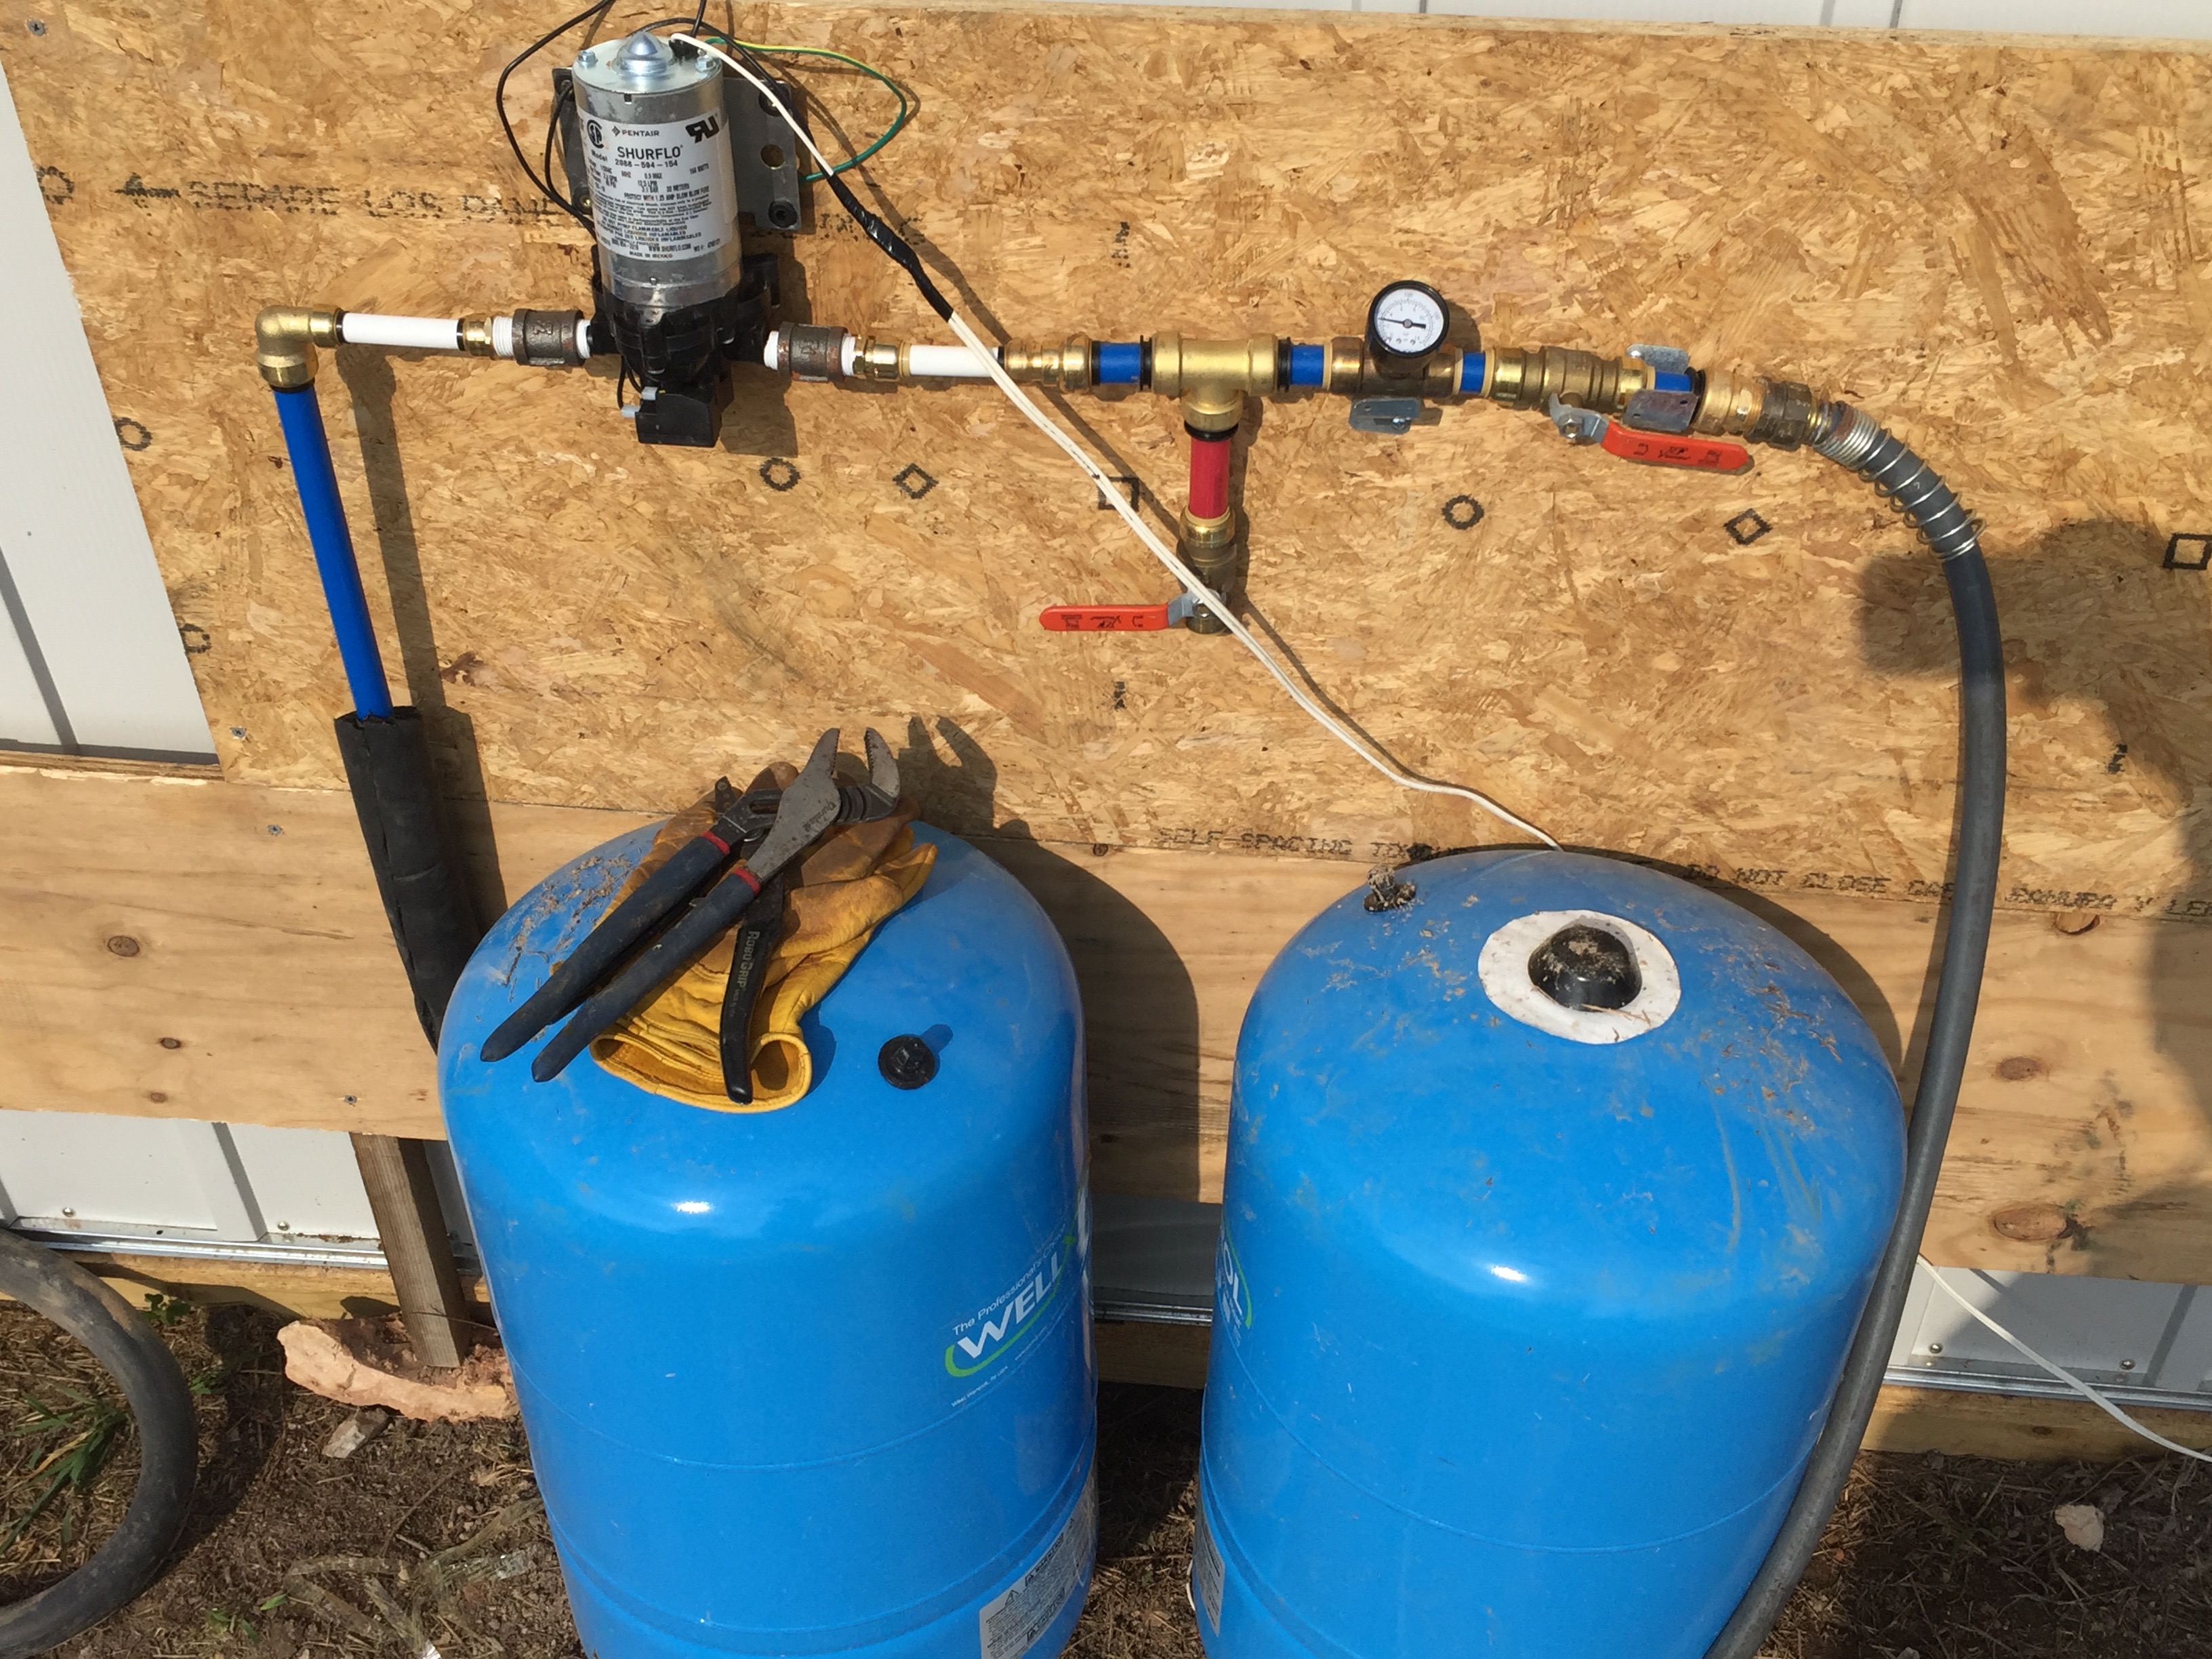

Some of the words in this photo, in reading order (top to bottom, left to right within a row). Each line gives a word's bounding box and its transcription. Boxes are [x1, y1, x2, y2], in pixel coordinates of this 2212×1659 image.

[591, 149, 608, 161] Model
[952, 1318, 975, 1336] The
[977, 1259, 1042, 1320] Professional's
